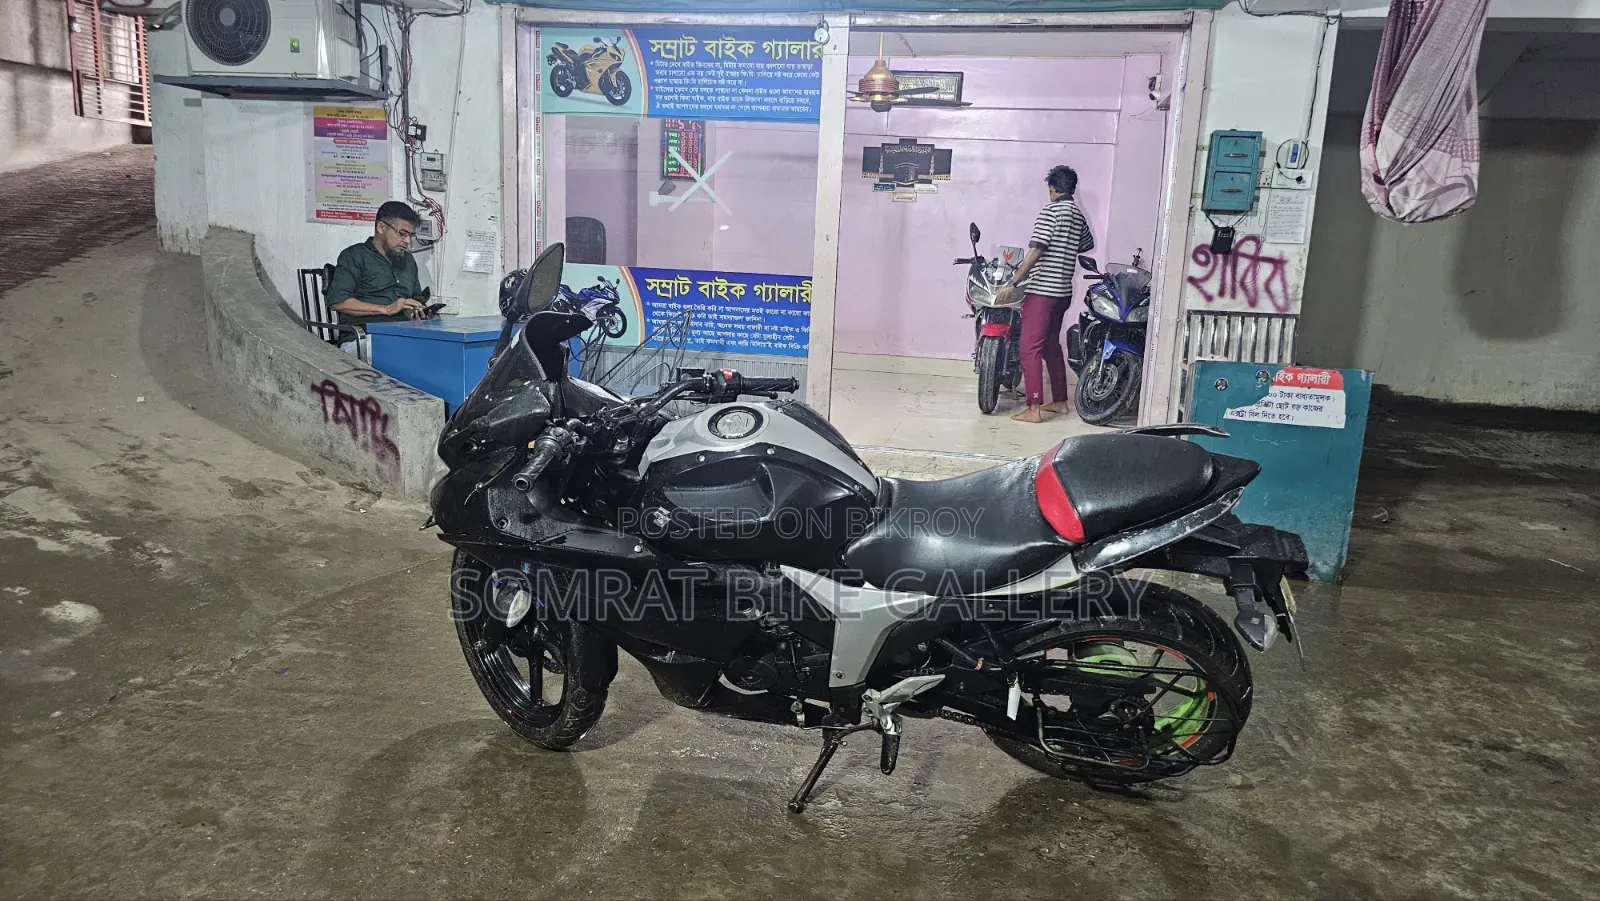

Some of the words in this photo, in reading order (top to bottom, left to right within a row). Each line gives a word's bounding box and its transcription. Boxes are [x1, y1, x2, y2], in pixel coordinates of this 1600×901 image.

[648, 34, 698, 61] সম্রাট
[703, 34, 756, 61] বাইক
[762, 38, 824, 60] গ্যালার
[645, 274, 692, 299] সম্রাট
[697, 276, 747, 302] বাইক
[1297, 371, 1330, 385] গ্যালারী
[1276, 402, 1289, 410] ছোট
[1262, 411, 1275, 419] দিতে
